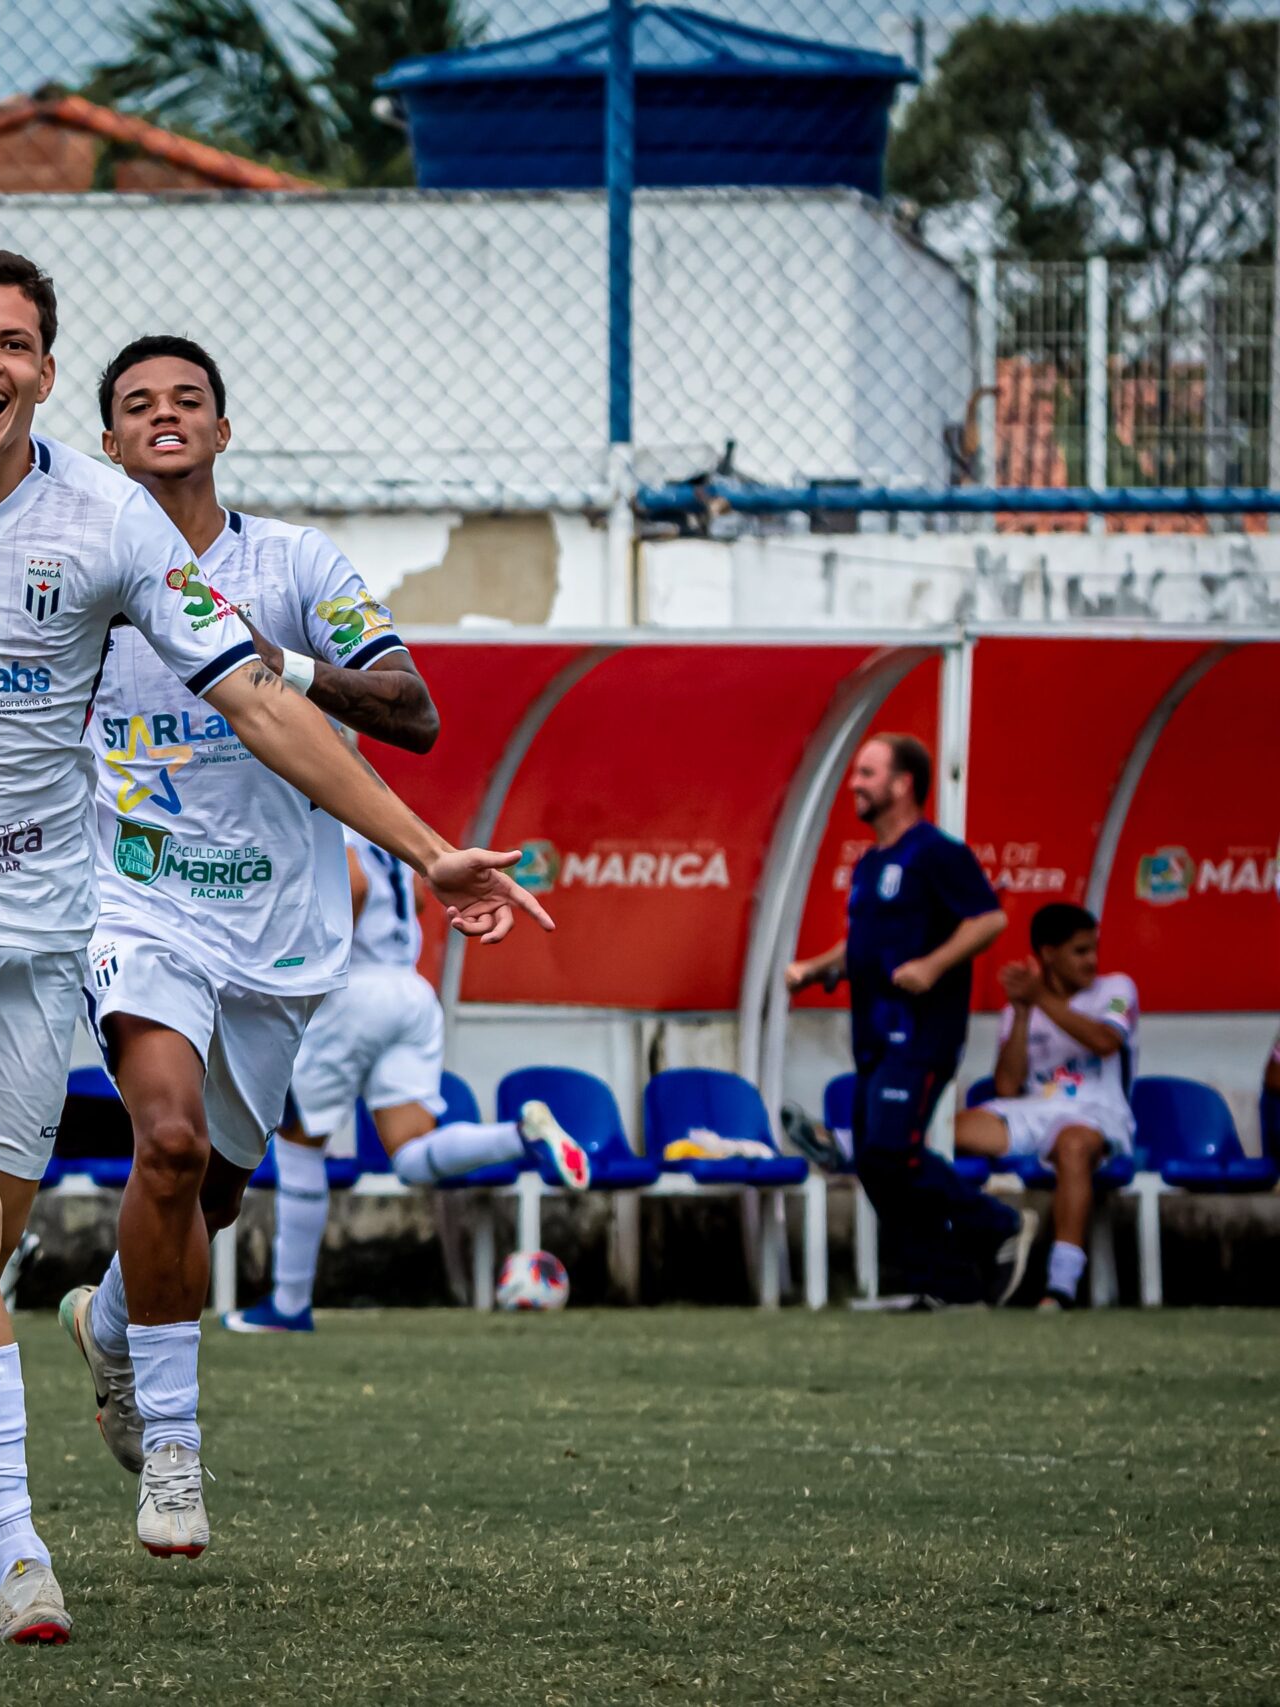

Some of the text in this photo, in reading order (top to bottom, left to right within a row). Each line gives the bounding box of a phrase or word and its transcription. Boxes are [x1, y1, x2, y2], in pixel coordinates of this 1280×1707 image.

[168, 841, 261, 860] FACULDADE DE
[190, 887, 244, 900] FACMAR
